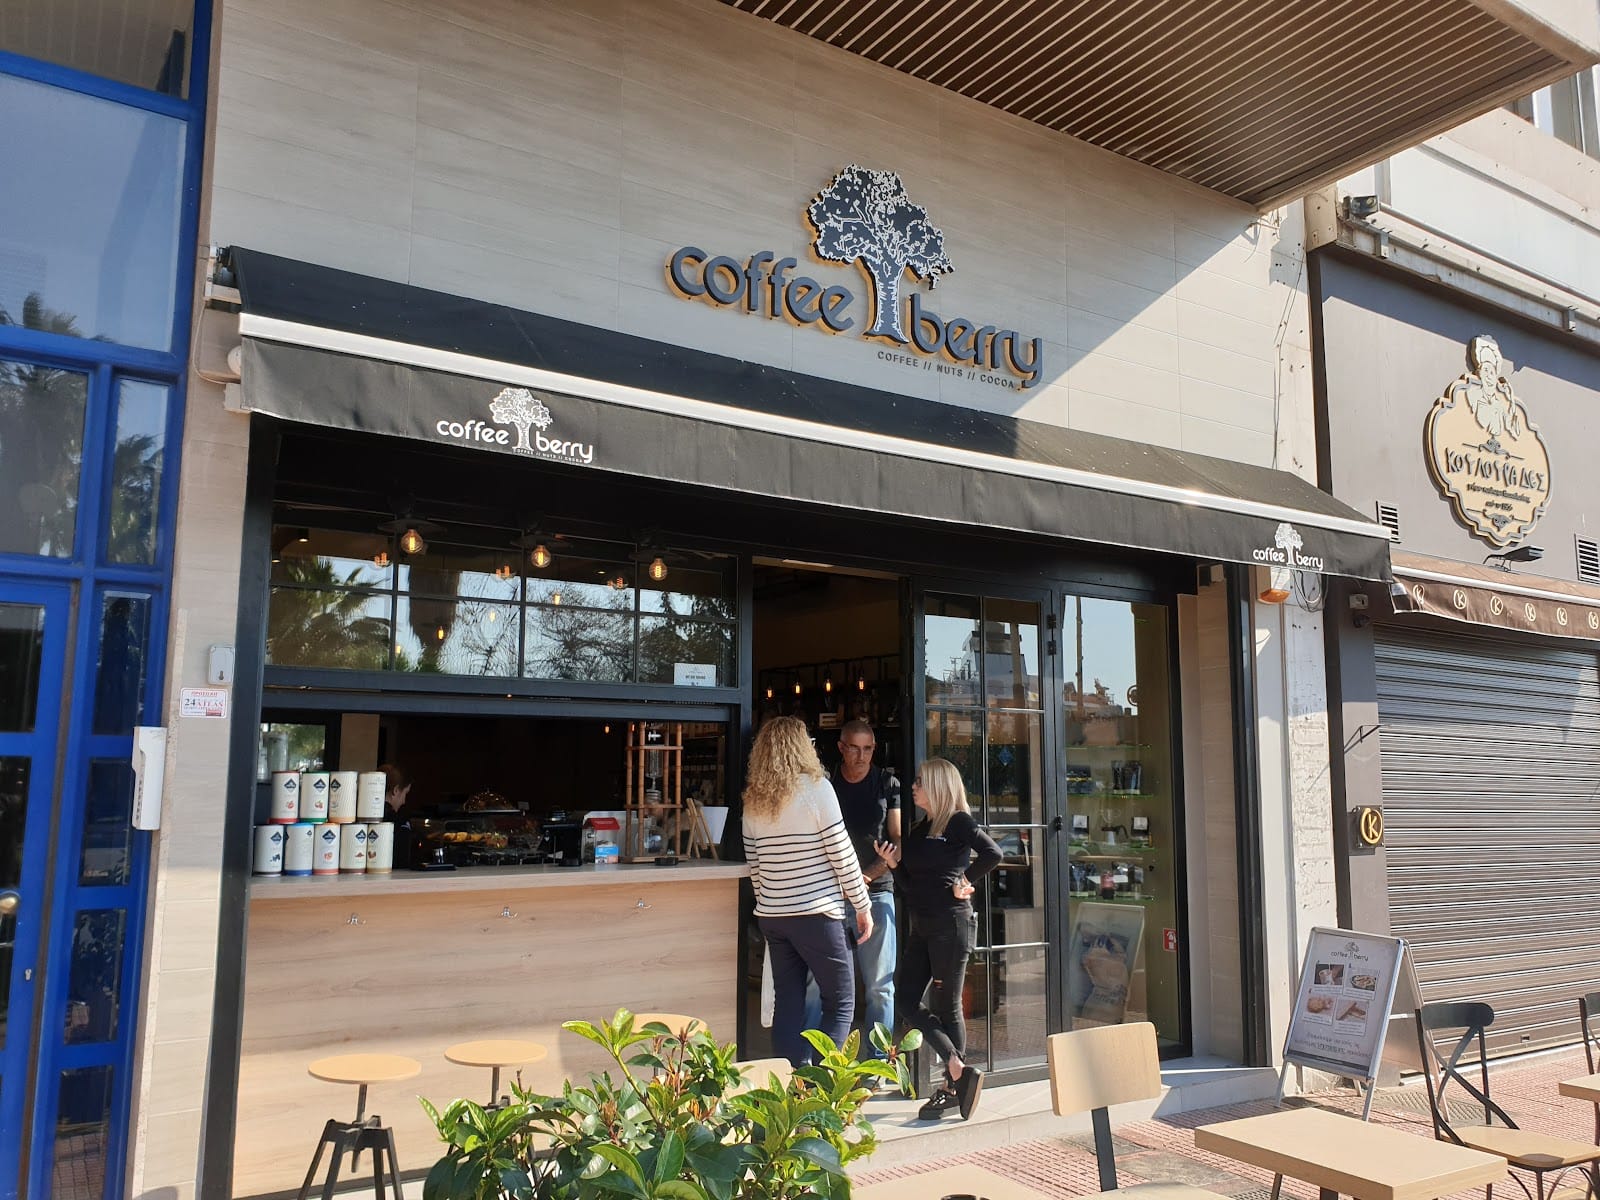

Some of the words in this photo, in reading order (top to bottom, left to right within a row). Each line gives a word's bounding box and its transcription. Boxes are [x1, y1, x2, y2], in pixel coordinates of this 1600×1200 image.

[667, 246, 855, 334] coffee
[906, 292, 1043, 389] berry
[877, 351, 919, 367] COFFEE
[936, 363, 964, 378] NUTS
[980, 374, 1015, 389] COCOA
[436, 420, 510, 445] coffee
[535, 431, 593, 464] berry
[1252, 547, 1286, 563] coffee
[1295, 551, 1324, 571] berry
[184, 698, 196, 706] 24
